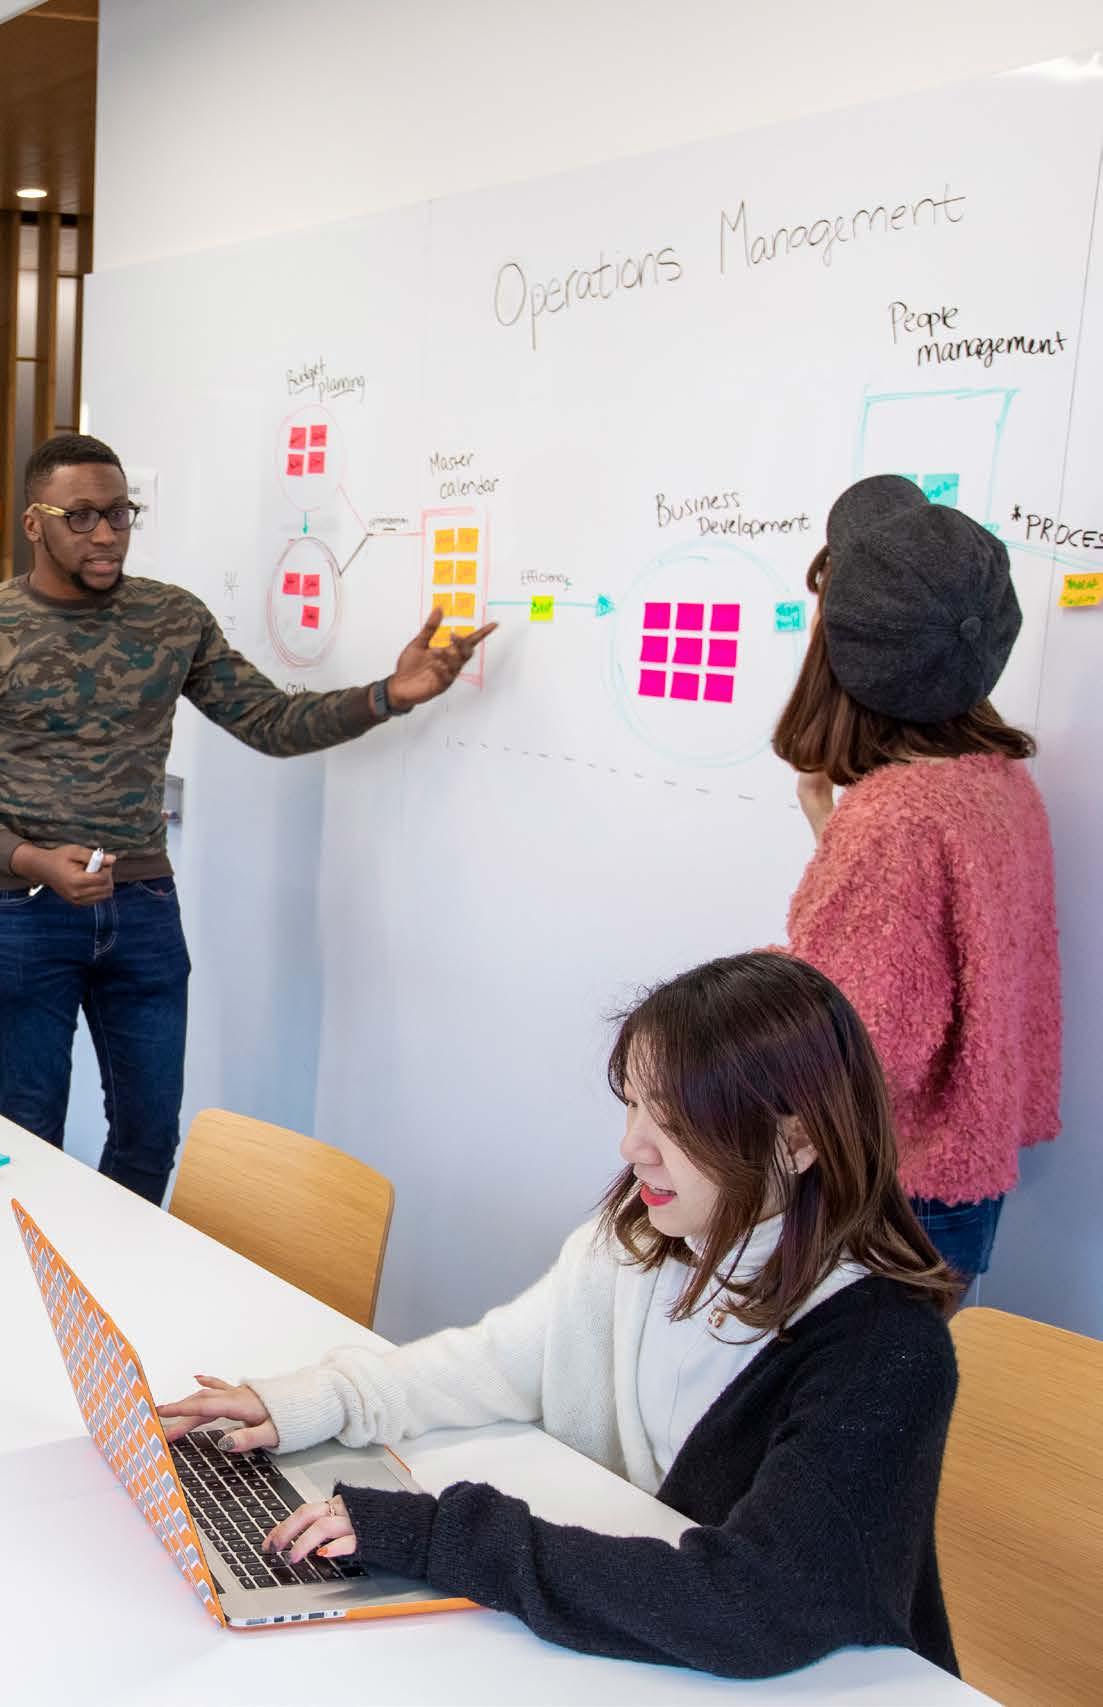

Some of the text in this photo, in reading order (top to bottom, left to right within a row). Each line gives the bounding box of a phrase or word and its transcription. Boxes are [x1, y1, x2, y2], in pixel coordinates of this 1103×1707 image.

[494, 183, 967, 352] Operations Management
[889, 300, 958, 345] People
[917, 331, 1067, 369] management
[429, 450, 475, 478] Master
[439, 473, 500, 500] calendar
[655, 491, 741, 528] Business
[697, 513, 811, 540] Development
